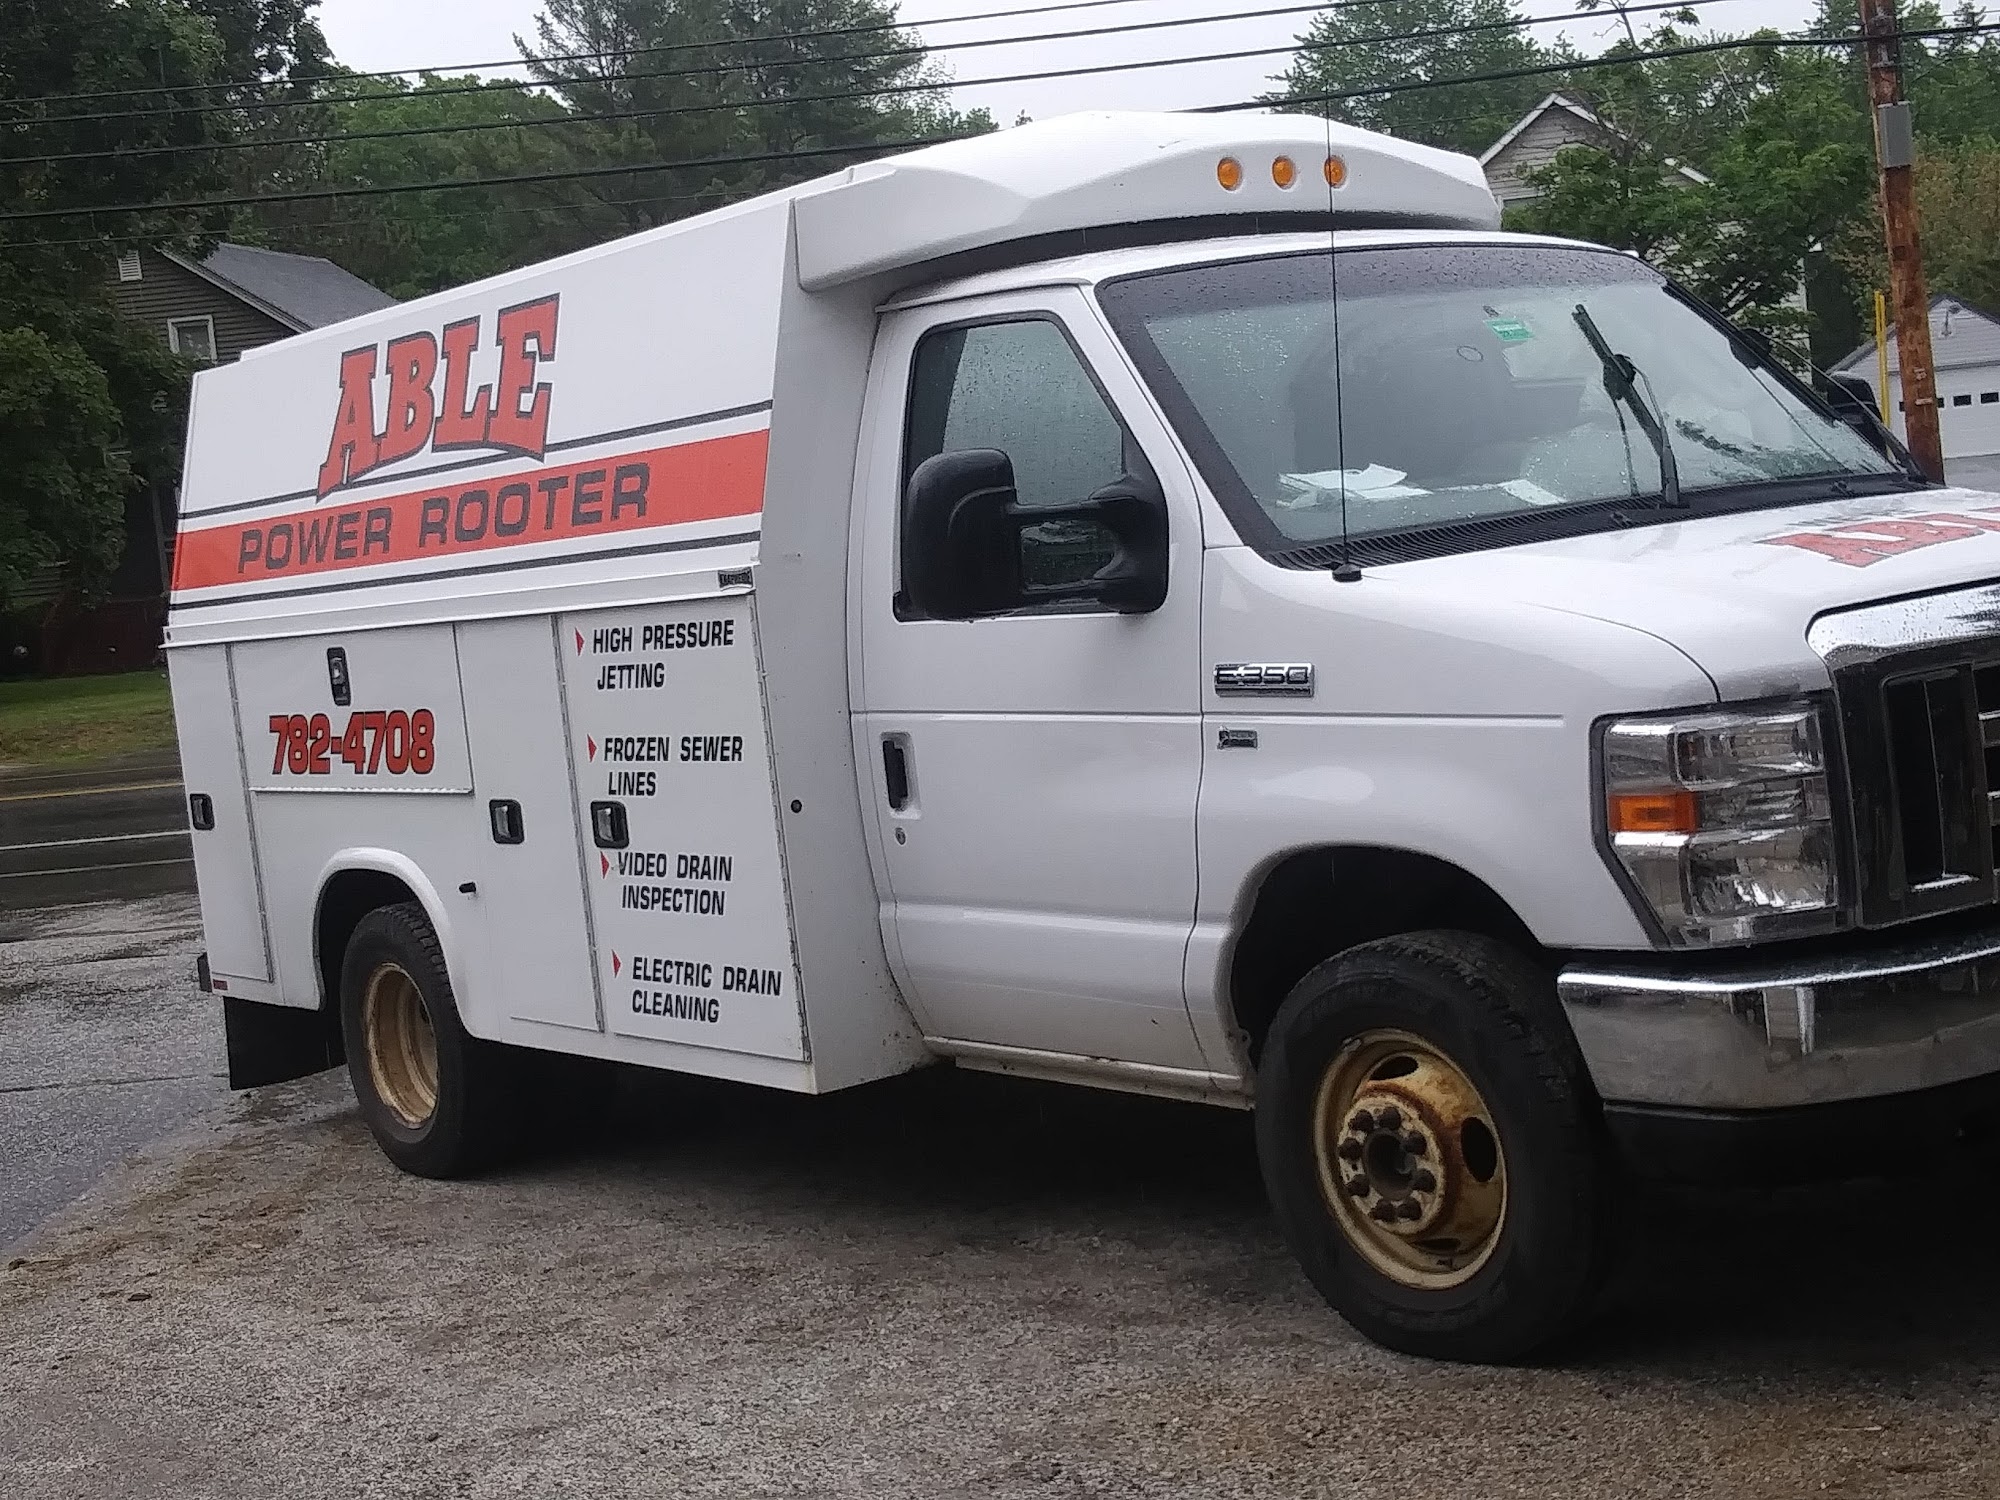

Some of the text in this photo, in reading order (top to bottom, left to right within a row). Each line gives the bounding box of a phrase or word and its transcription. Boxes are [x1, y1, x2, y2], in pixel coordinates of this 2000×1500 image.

[316, 293, 560, 502] ABLE
[238, 462, 652, 574] POWER ROOTER
[593, 620, 735, 653] HIGH PRESSURE
[597, 662, 666, 690] JETTING
[269, 708, 435, 775] 782-4708
[603, 735, 743, 762] FROZEN SEWER
[608, 771, 656, 797] LINES
[617, 851, 733, 882] VIDEO DRAIN
[621, 884, 726, 916] INSPECTION
[632, 956, 782, 996] ELECTRIC DRAIN
[632, 989, 720, 1024] CLEANING
